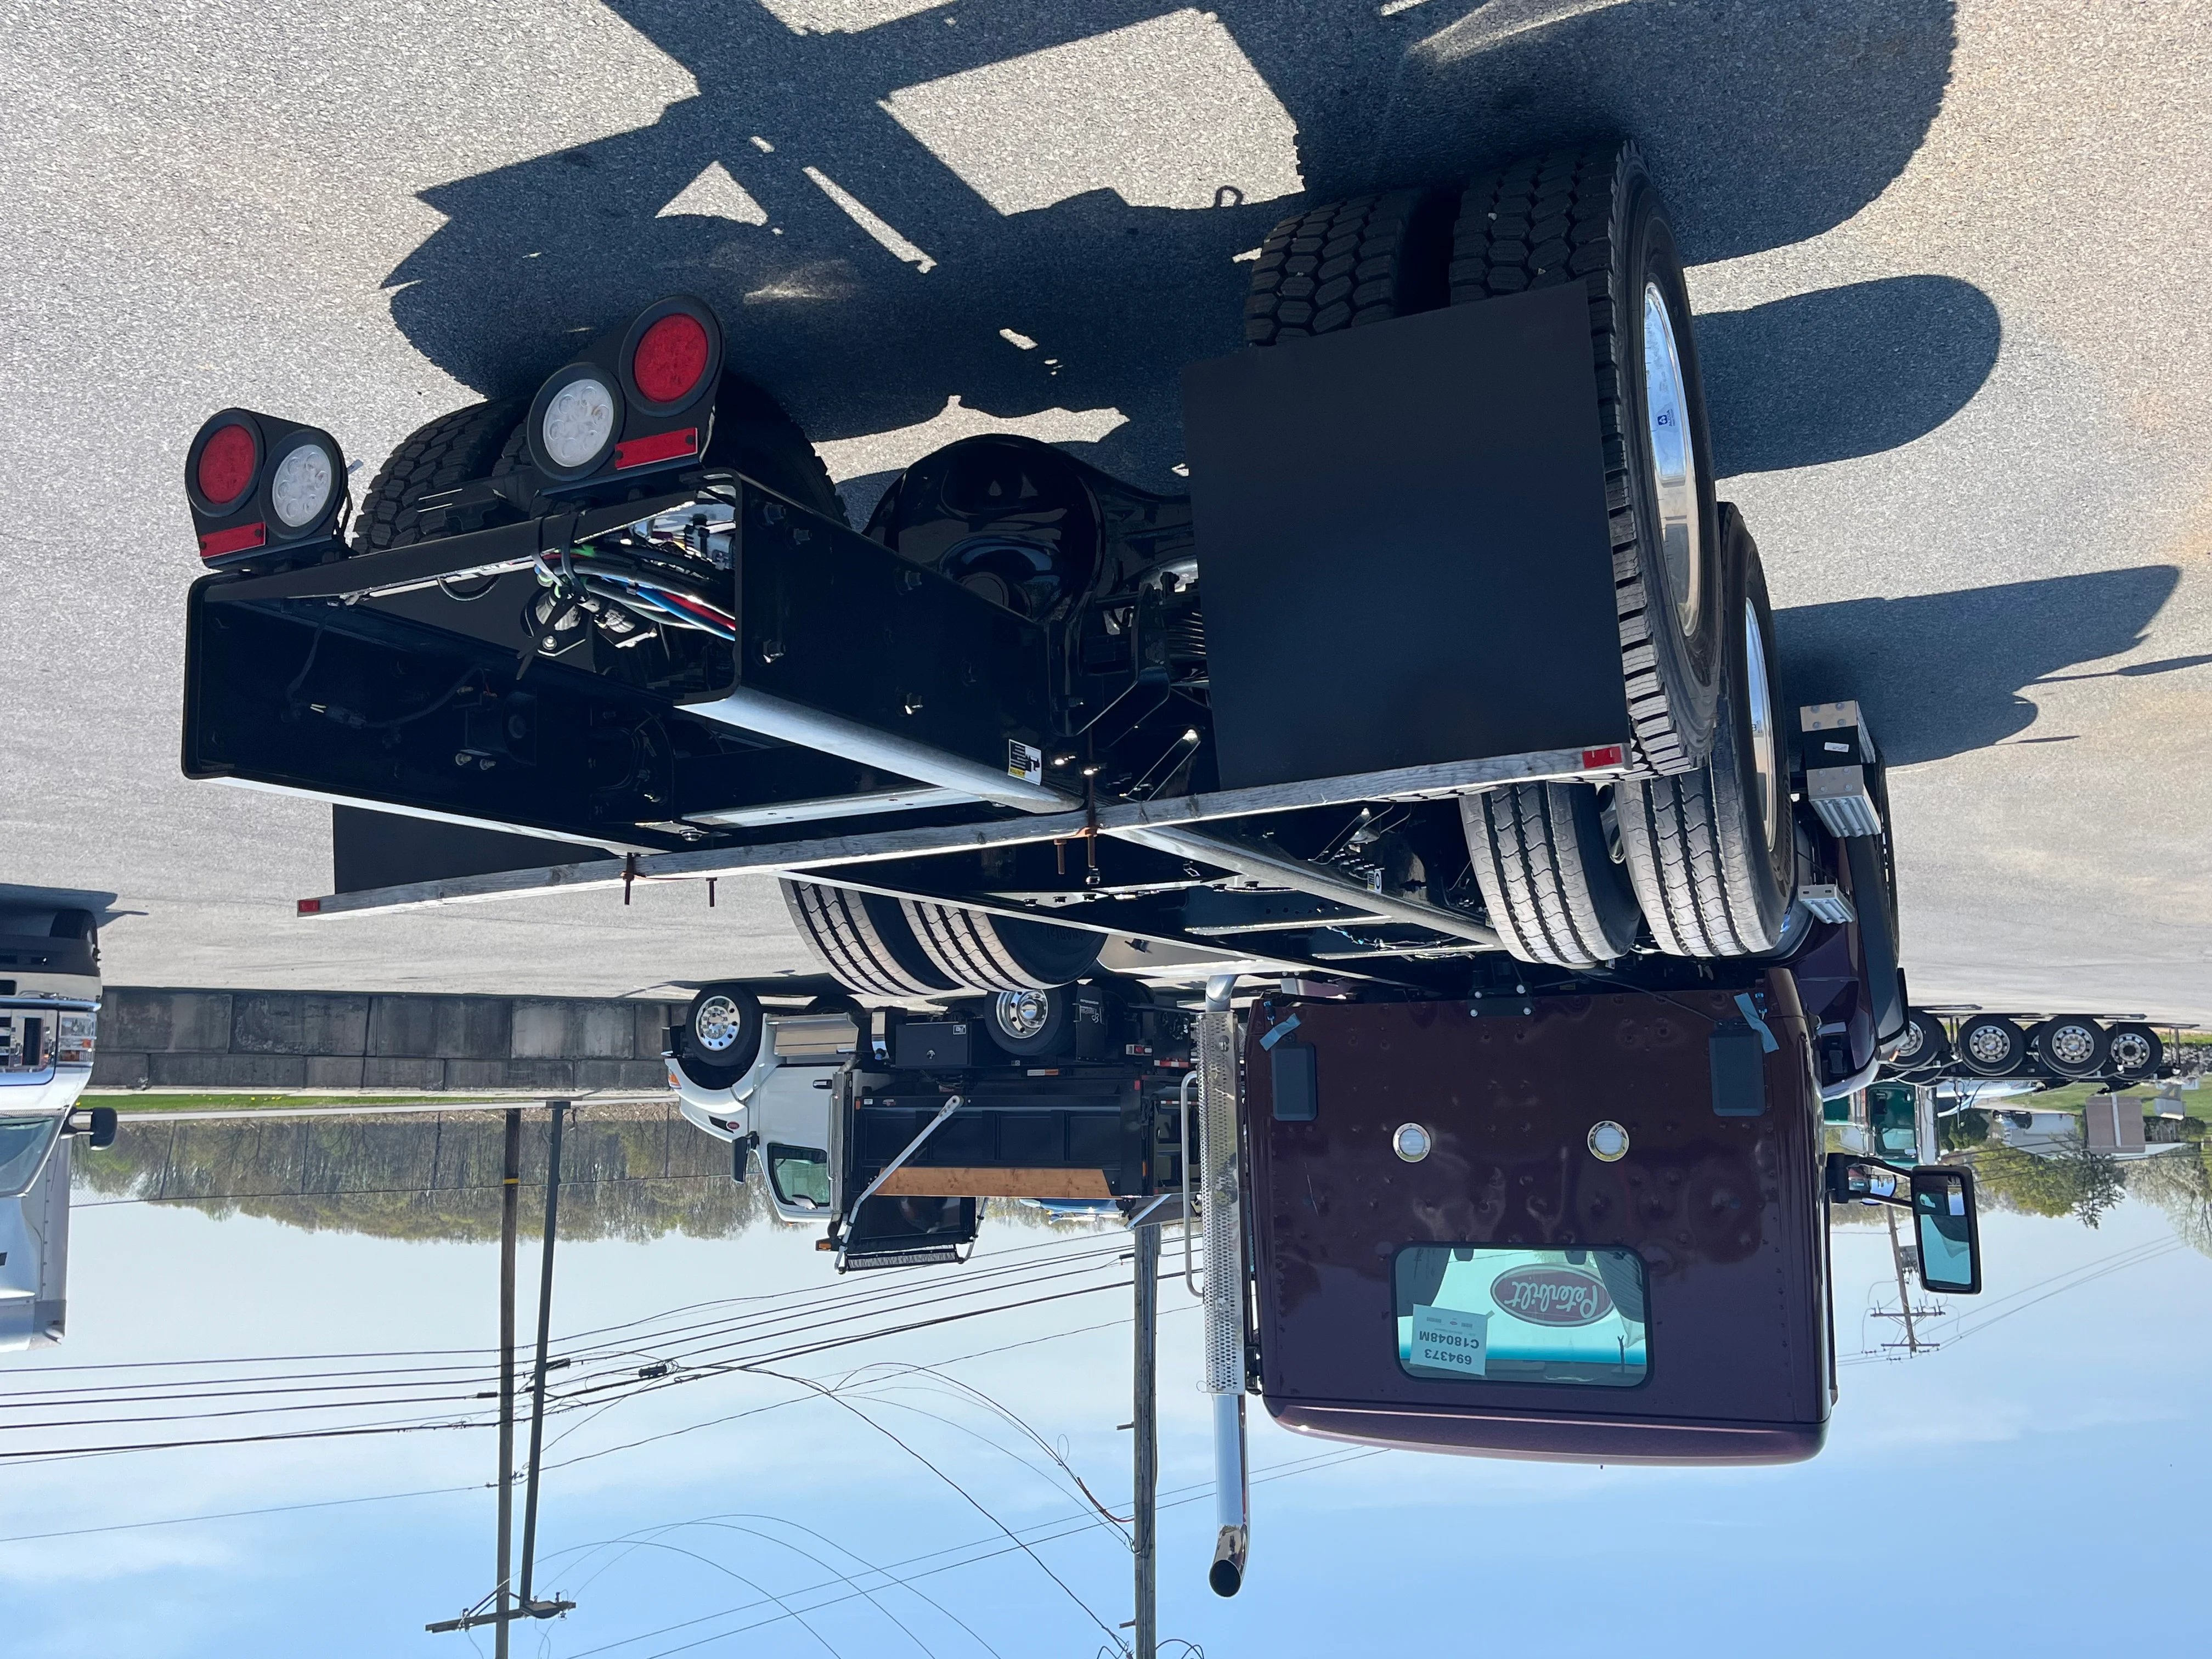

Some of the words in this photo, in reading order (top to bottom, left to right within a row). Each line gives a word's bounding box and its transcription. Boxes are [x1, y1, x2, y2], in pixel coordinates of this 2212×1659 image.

[1504, 1281, 1598, 1318] Peterbilt
[1419, 1330, 1480, 1349] C18048M
[1424, 1348, 1472, 1365] 694373
